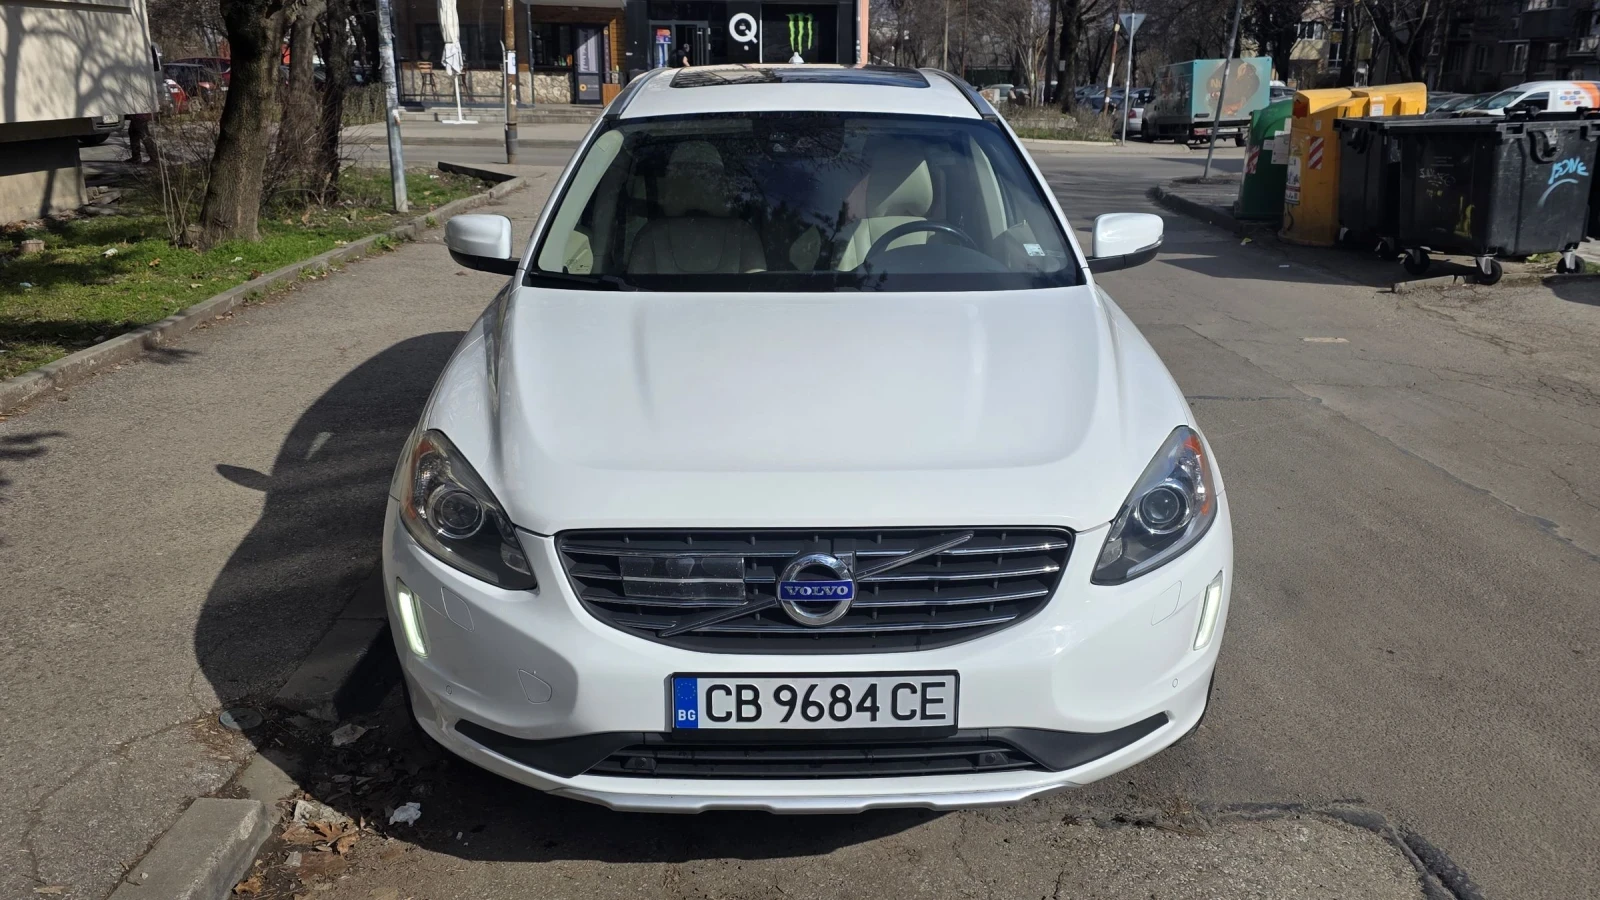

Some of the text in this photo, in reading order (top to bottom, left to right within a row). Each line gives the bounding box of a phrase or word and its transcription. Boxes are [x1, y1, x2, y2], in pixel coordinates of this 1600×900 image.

[729, 12, 758, 43] Q
[784, 586, 848, 596] VOLVO
[705, 681, 946, 723] CB 9684 CE
[678, 709, 696, 721] BG
